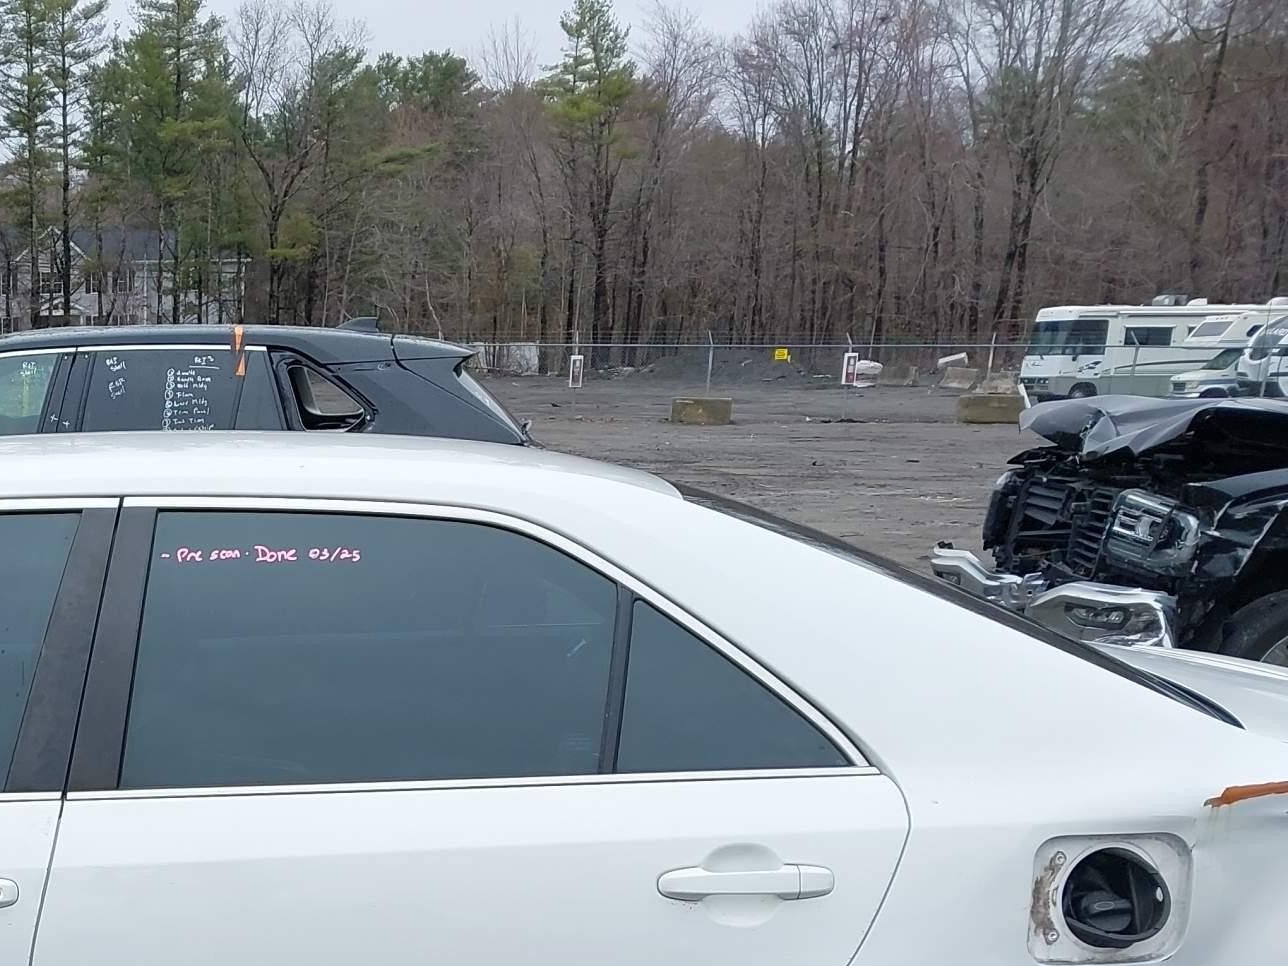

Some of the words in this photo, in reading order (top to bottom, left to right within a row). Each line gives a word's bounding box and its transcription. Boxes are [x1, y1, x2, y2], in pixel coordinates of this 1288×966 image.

[176, 547, 203, 563] Pre
[254, 545, 298, 563] Done
[308, 546, 361, 562] 03/25
